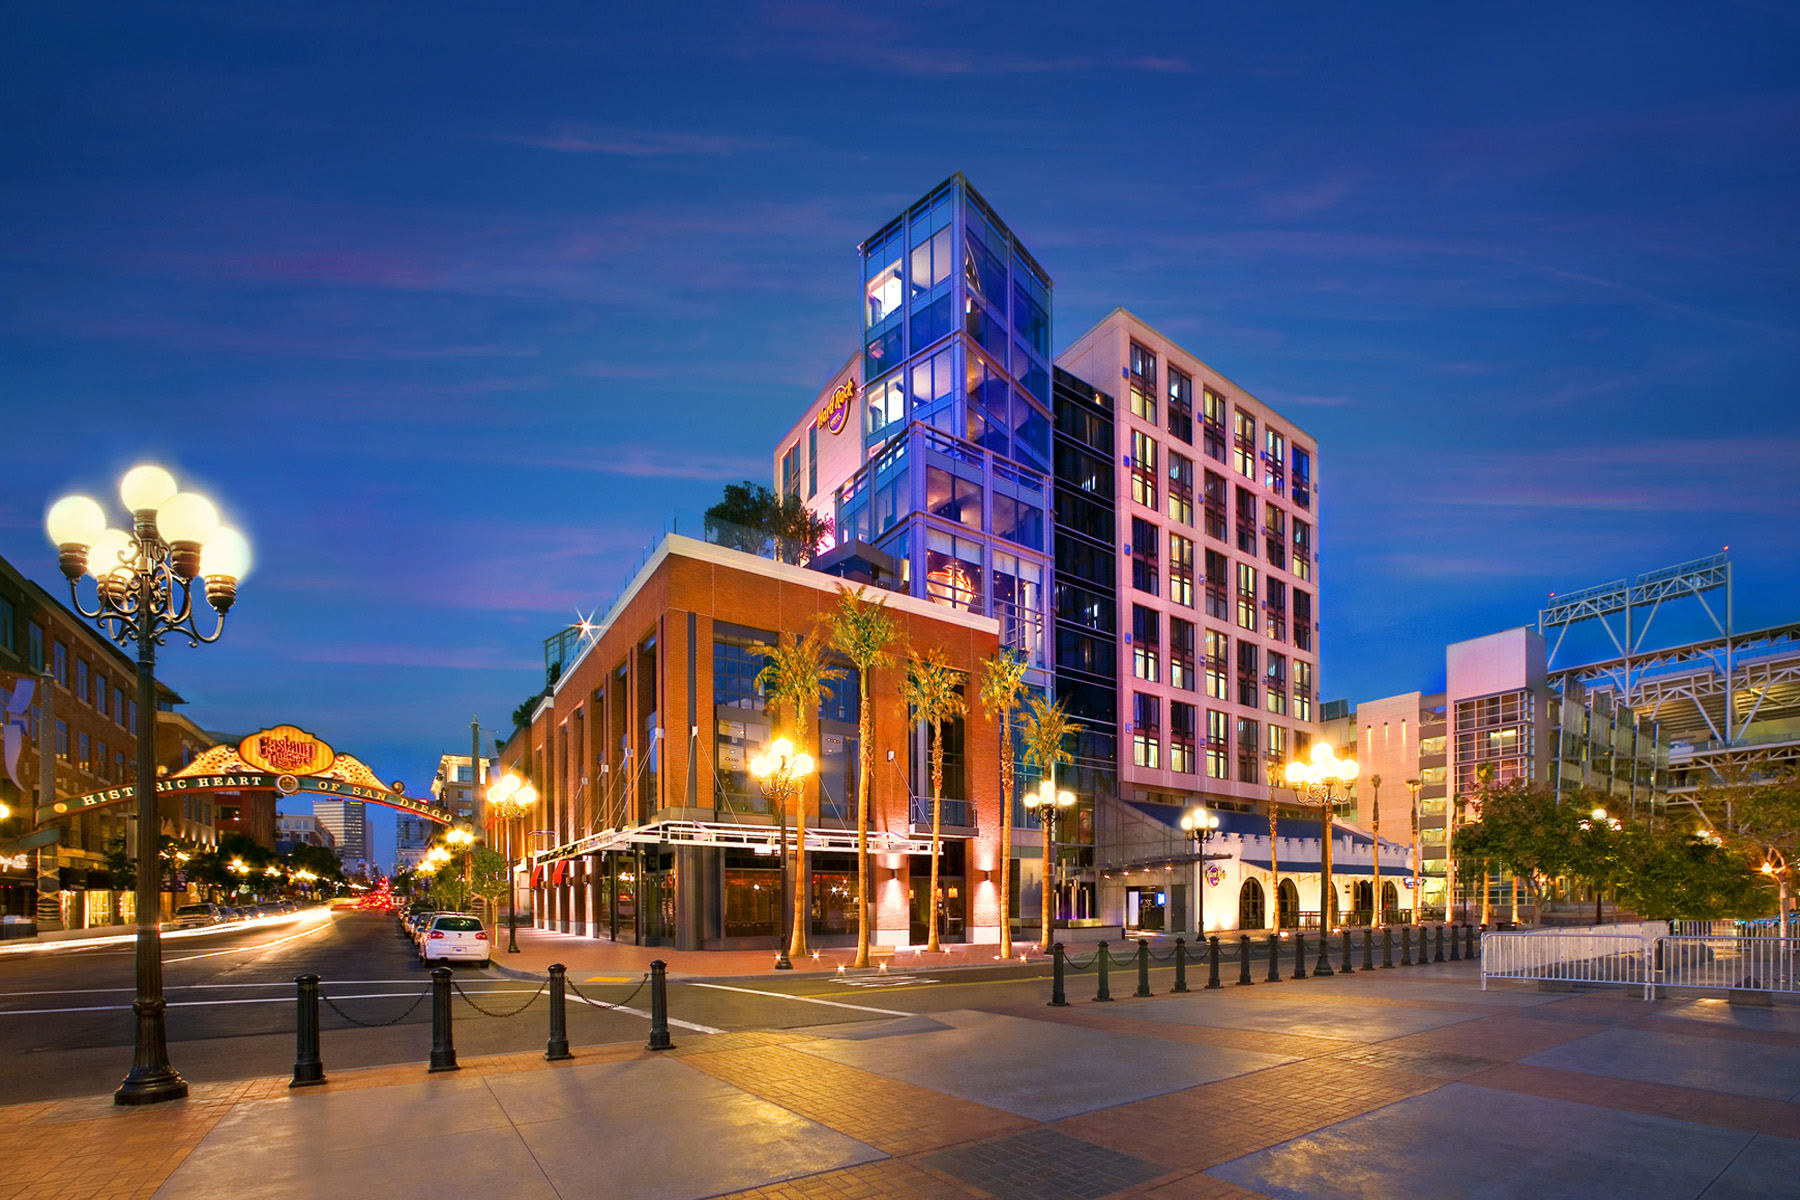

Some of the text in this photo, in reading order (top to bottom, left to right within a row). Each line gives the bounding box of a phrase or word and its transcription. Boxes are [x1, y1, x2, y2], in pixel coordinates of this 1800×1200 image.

[81, 776, 453, 822] HISTRIC HEART OF SAN DIEGO
